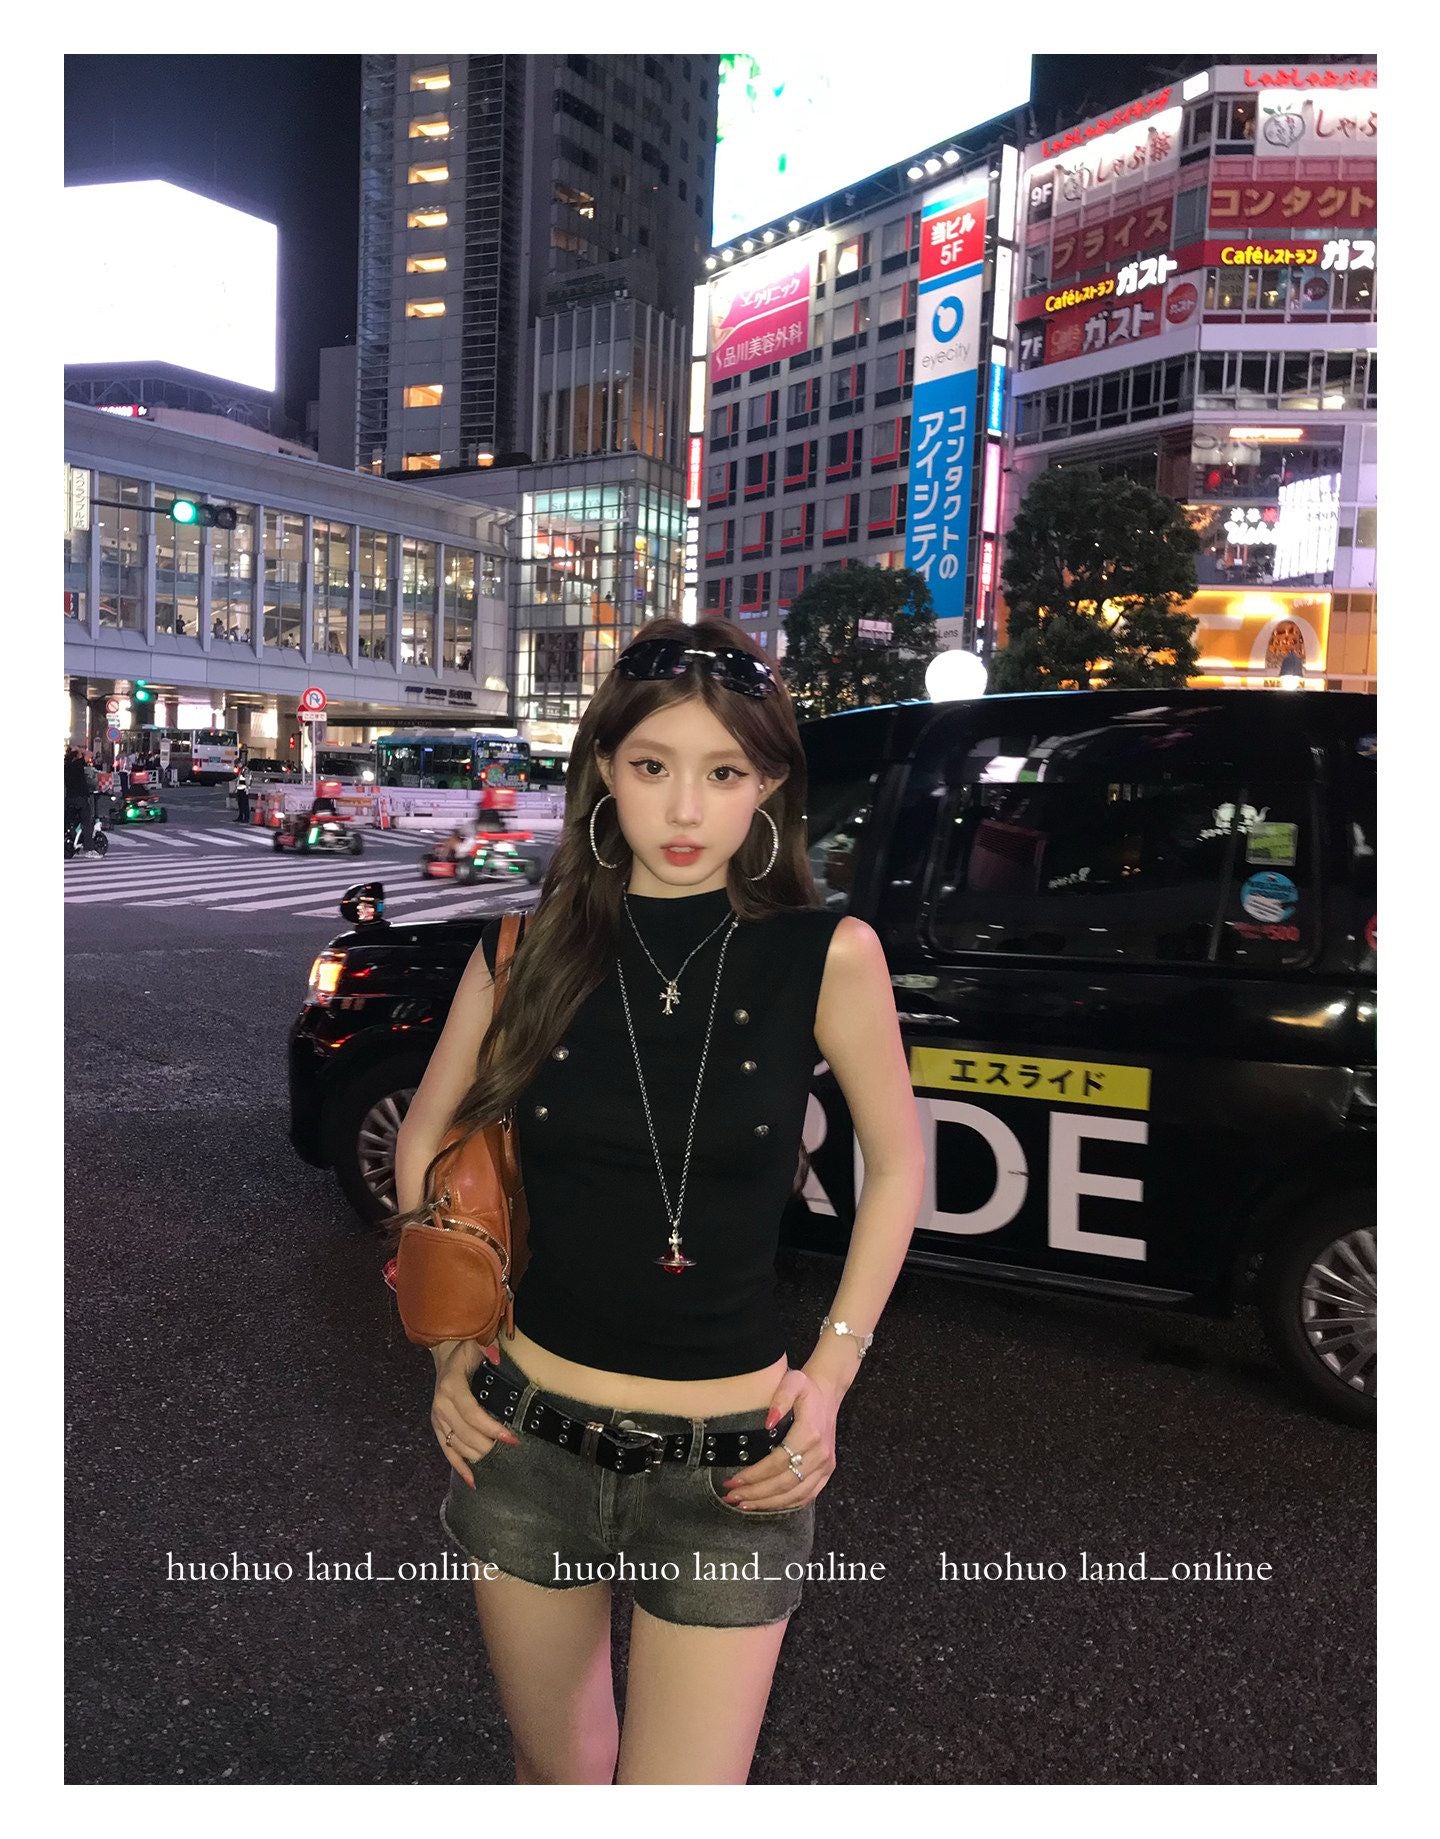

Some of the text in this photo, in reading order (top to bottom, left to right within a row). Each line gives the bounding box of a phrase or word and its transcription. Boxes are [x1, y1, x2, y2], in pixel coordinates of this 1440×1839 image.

[1030, 183, 1053, 207] 9F
[1210, 185, 1376, 219] コンタクト
[930, 212, 976, 246] 当ビル
[1053, 205, 1169, 270] プライス
[939, 239, 965, 266] 5F
[1115, 253, 1178, 297] ガスト
[723, 320, 804, 369] 品川美容外科
[1020, 335, 1043, 360] 7F
[1082, 303, 1155, 353] ガスト
[921, 342, 971, 370] eyecity
[912, 410, 945, 582] アイシティ
[938, 405, 967, 580] コンタクトの
[949, 1058, 1106, 1097] エスライド
